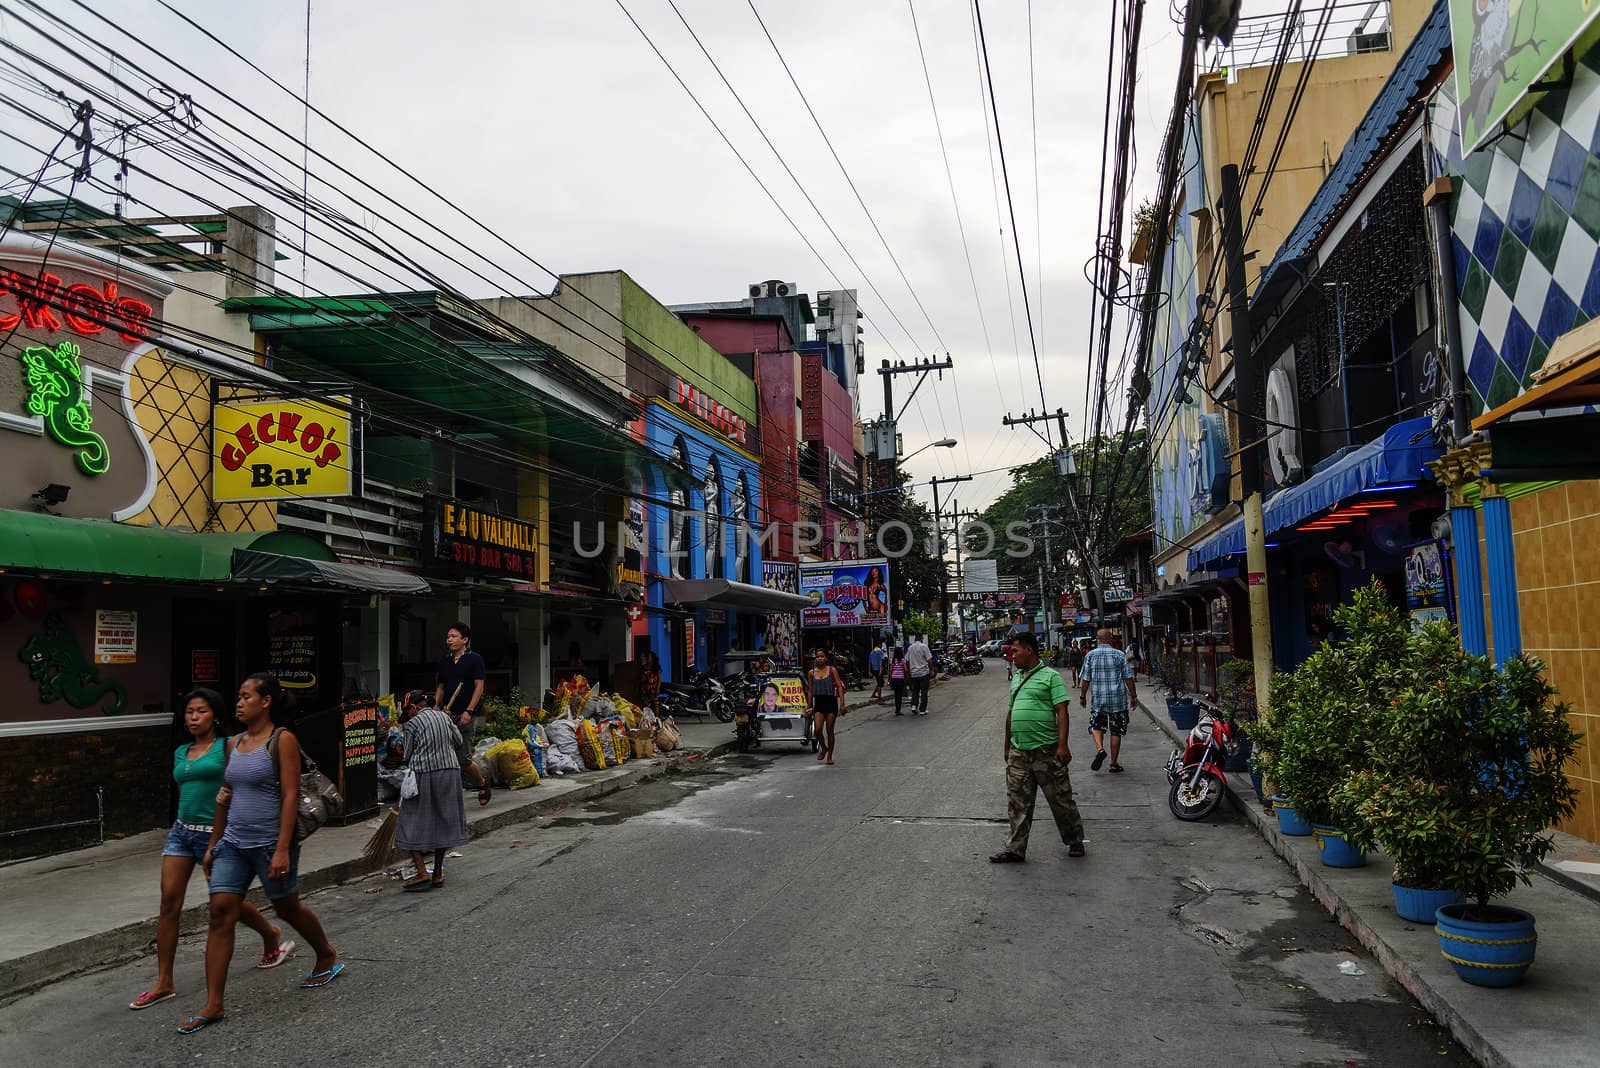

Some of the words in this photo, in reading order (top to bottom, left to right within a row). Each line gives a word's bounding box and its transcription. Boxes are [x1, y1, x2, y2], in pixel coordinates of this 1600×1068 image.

[221, 411, 342, 472] GECKO'S
[251, 463, 312, 488] Bar
[443, 503, 455, 536] E
[457, 507, 468, 538] 4
[469, 511, 480, 541] U
[481, 513, 538, 554] VALHALLA
[482, 545, 503, 569] BAR
[824, 583, 868, 604] BIKINI
[1105, 590, 1133, 601] SALON
